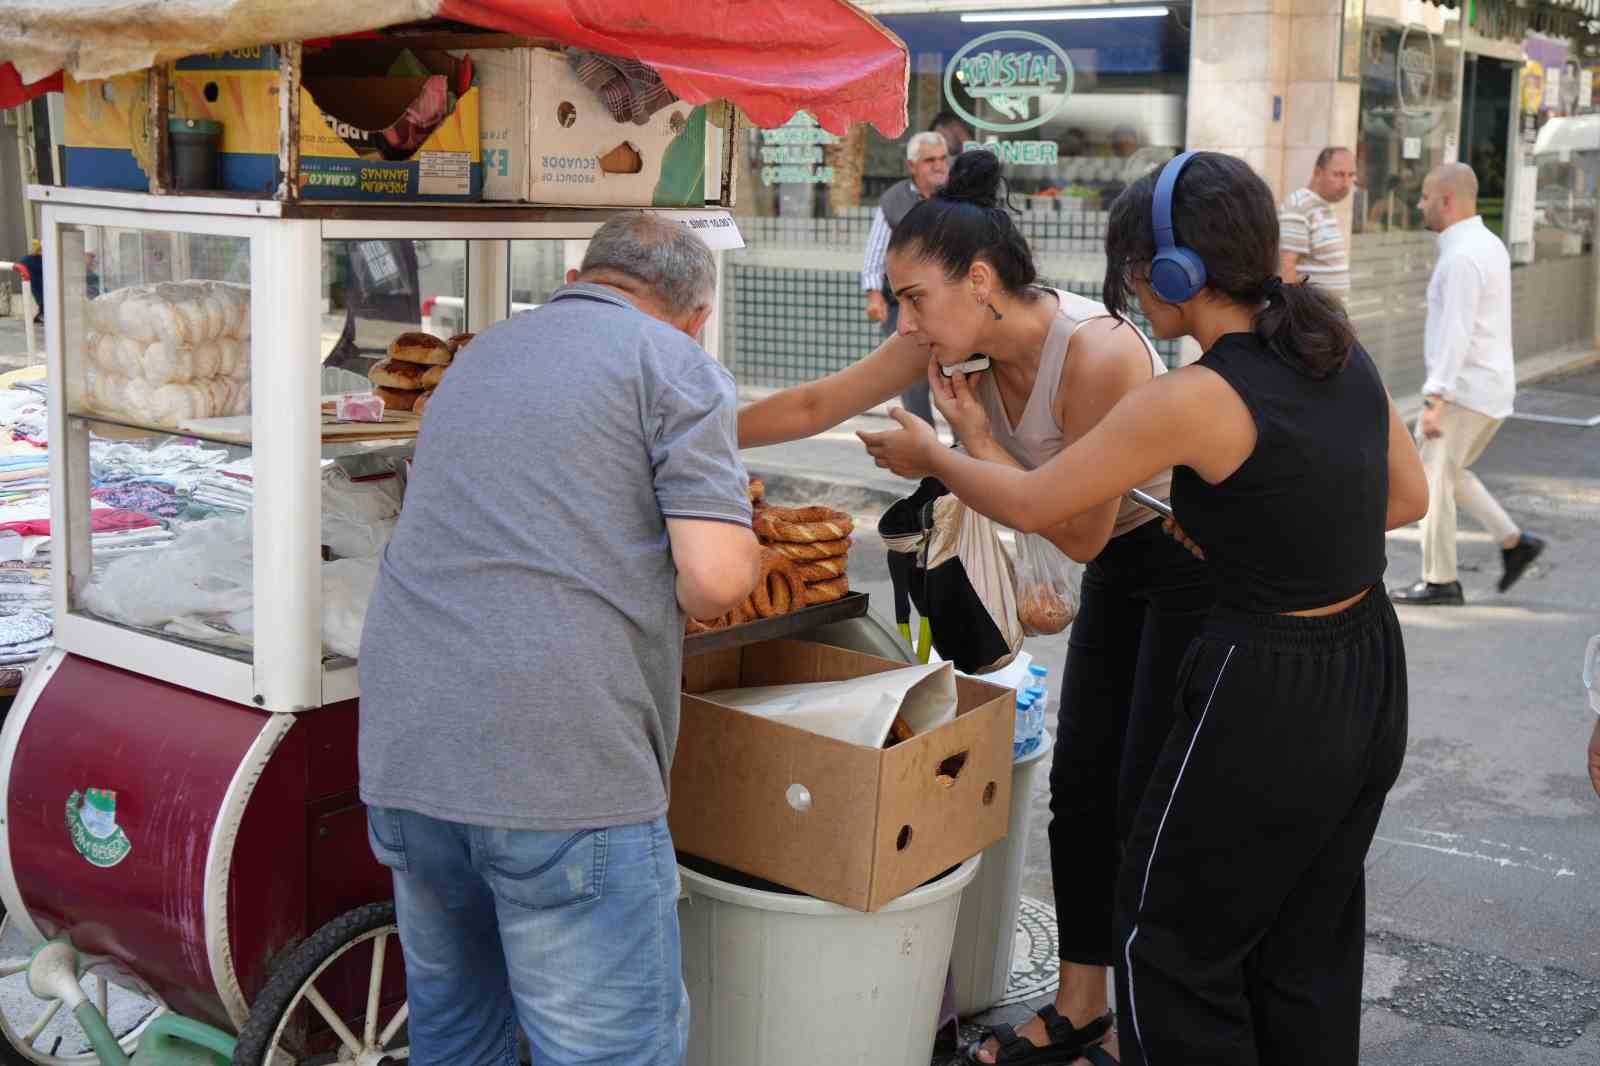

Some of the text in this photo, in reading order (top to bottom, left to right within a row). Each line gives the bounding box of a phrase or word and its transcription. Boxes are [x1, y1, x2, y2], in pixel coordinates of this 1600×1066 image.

[542, 156, 596, 169] ECUADOR
[360, 167, 409, 181] BANANAS
[542, 174, 595, 184] PRODUCT OF
[361, 181, 408, 194] PREMIUM
